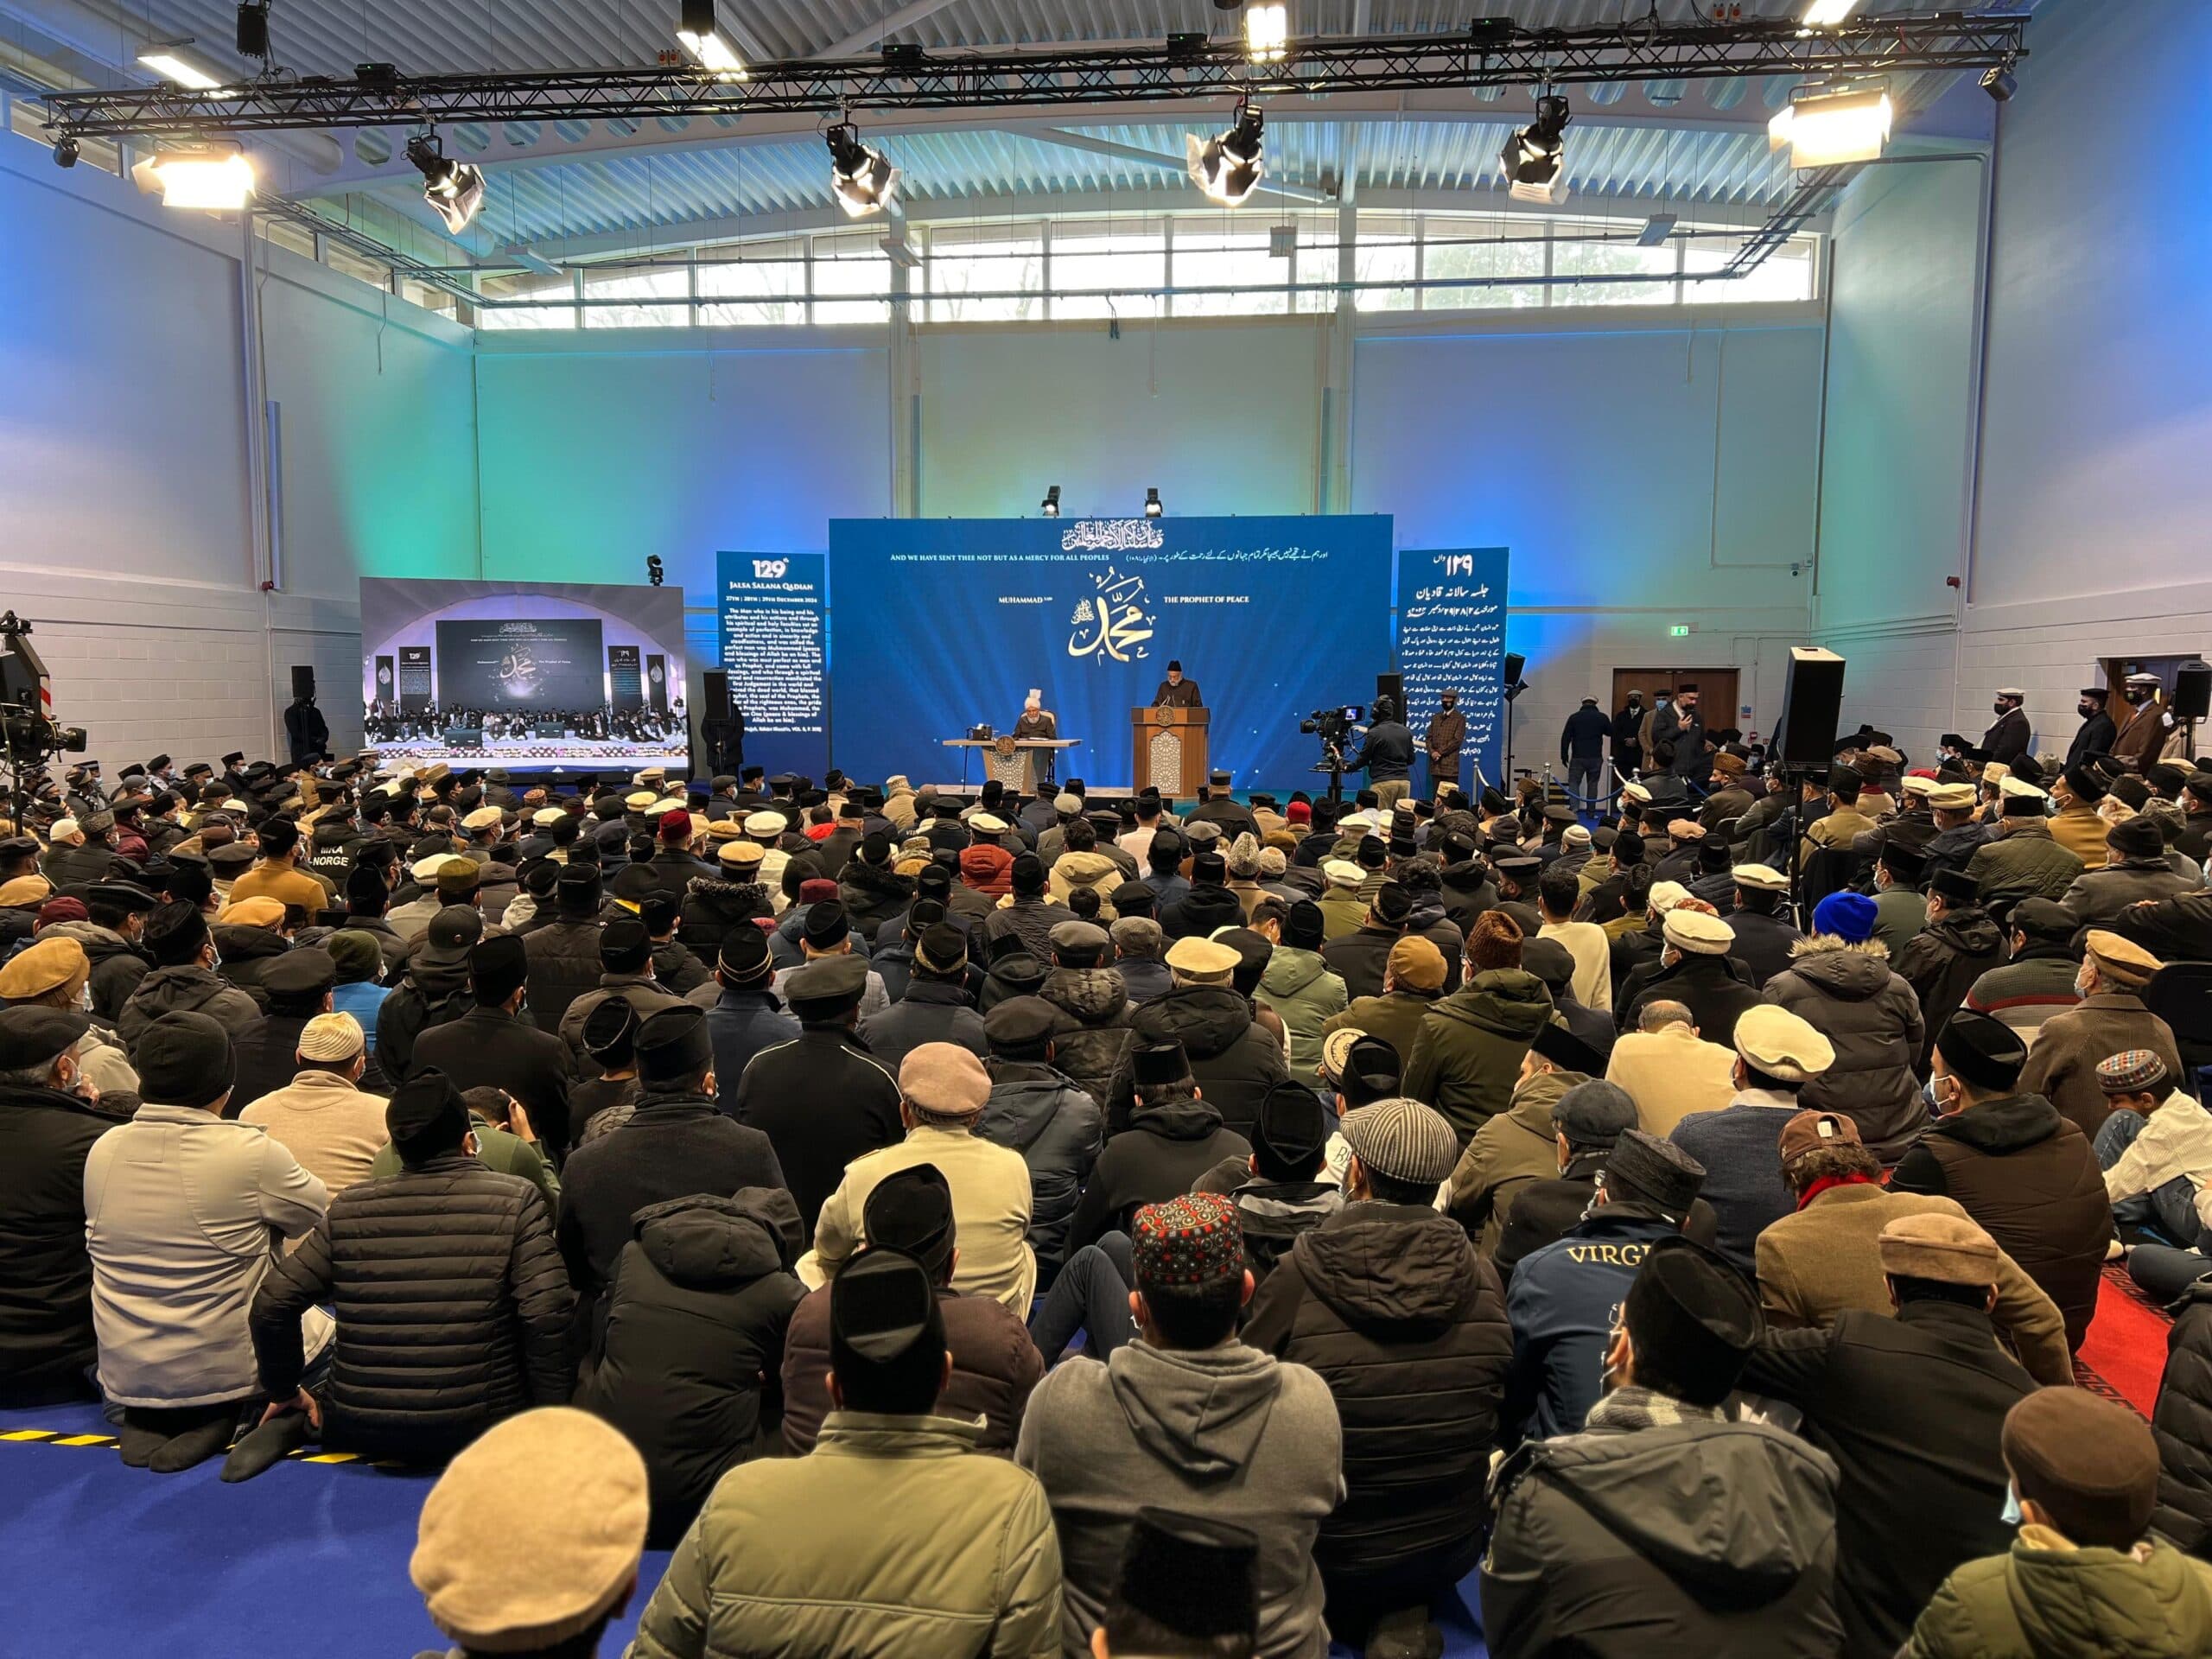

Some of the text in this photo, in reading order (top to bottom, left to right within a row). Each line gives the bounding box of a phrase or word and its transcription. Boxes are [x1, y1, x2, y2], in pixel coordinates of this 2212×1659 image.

[752, 582, 782, 590] SALANA
[782, 583, 813, 591] QADIAN
[1416, 586, 1444, 601] قادیان
[313, 856, 349, 866] NORGE
